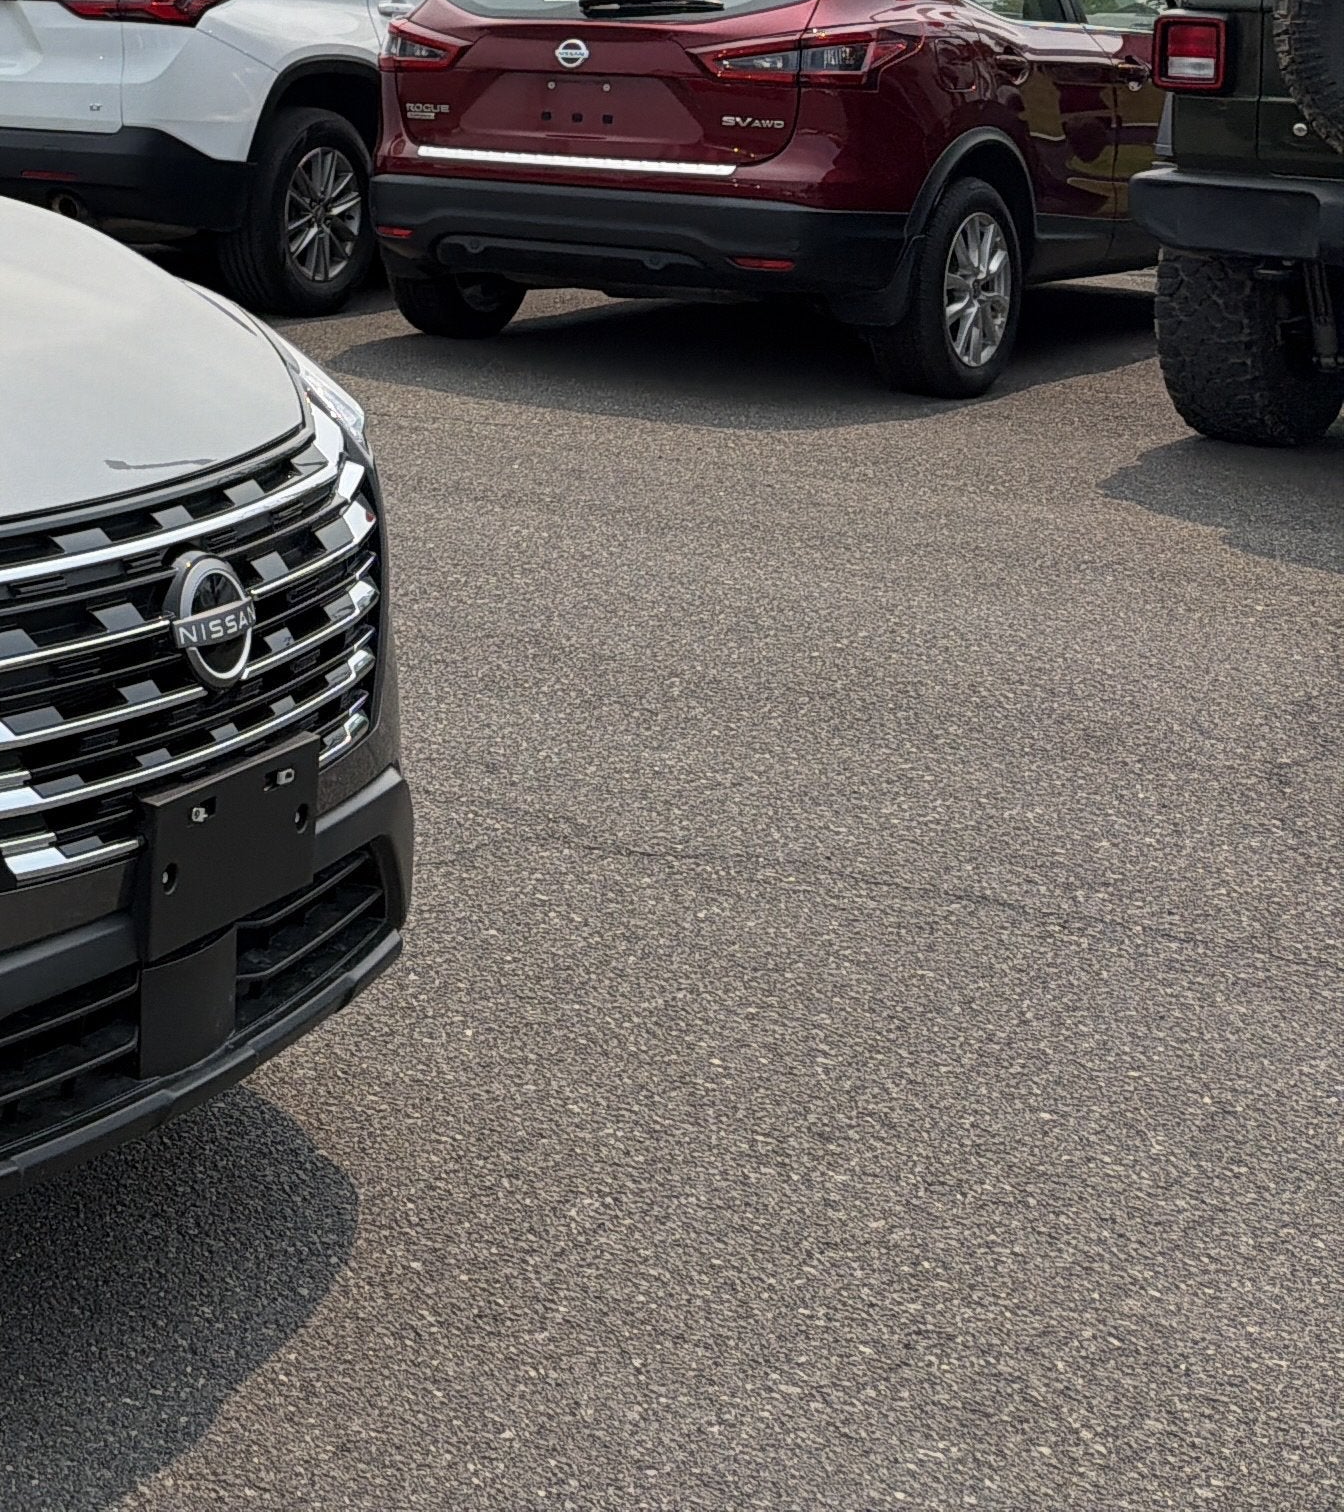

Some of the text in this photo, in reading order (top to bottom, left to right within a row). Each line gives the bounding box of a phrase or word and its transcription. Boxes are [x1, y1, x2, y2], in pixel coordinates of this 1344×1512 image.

[405, 102, 450, 113] ROGUE
[722, 116, 785, 129] SV AWD
[178, 604, 257, 645] NISSAN
